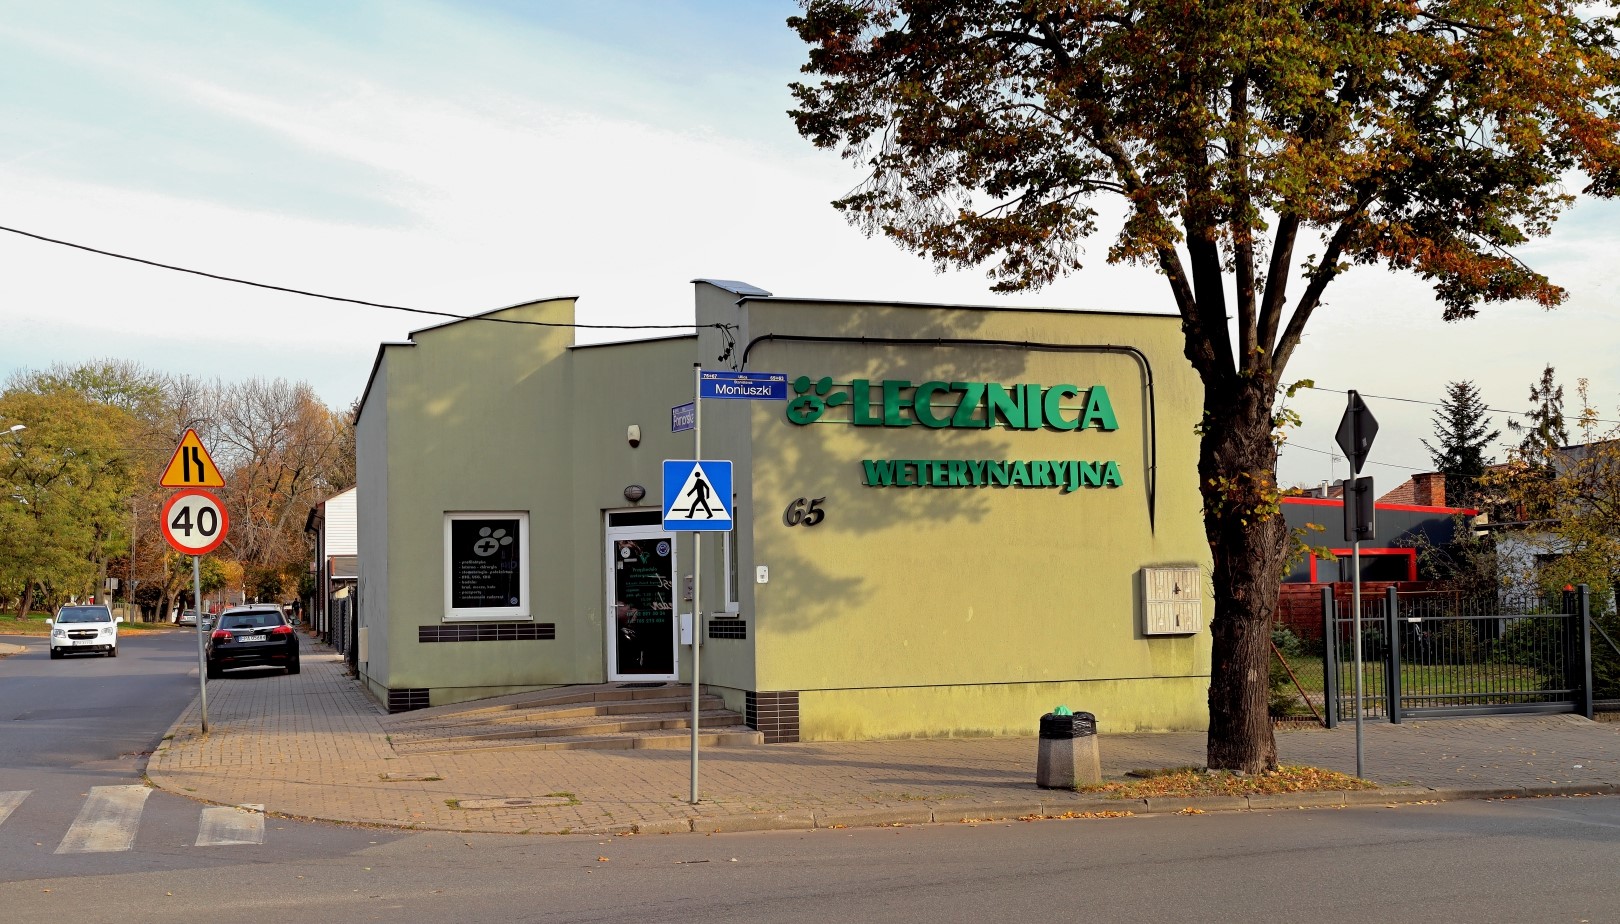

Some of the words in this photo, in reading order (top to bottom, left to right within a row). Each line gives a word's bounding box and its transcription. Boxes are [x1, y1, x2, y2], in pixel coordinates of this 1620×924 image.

[715, 383, 772, 396] Moniuszki
[852, 379, 1119, 430] LECZNICA
[862, 459, 1124, 492] WETERYNARYJNA
[171, 506, 218, 537] 40
[785, 496, 826, 527] 65
